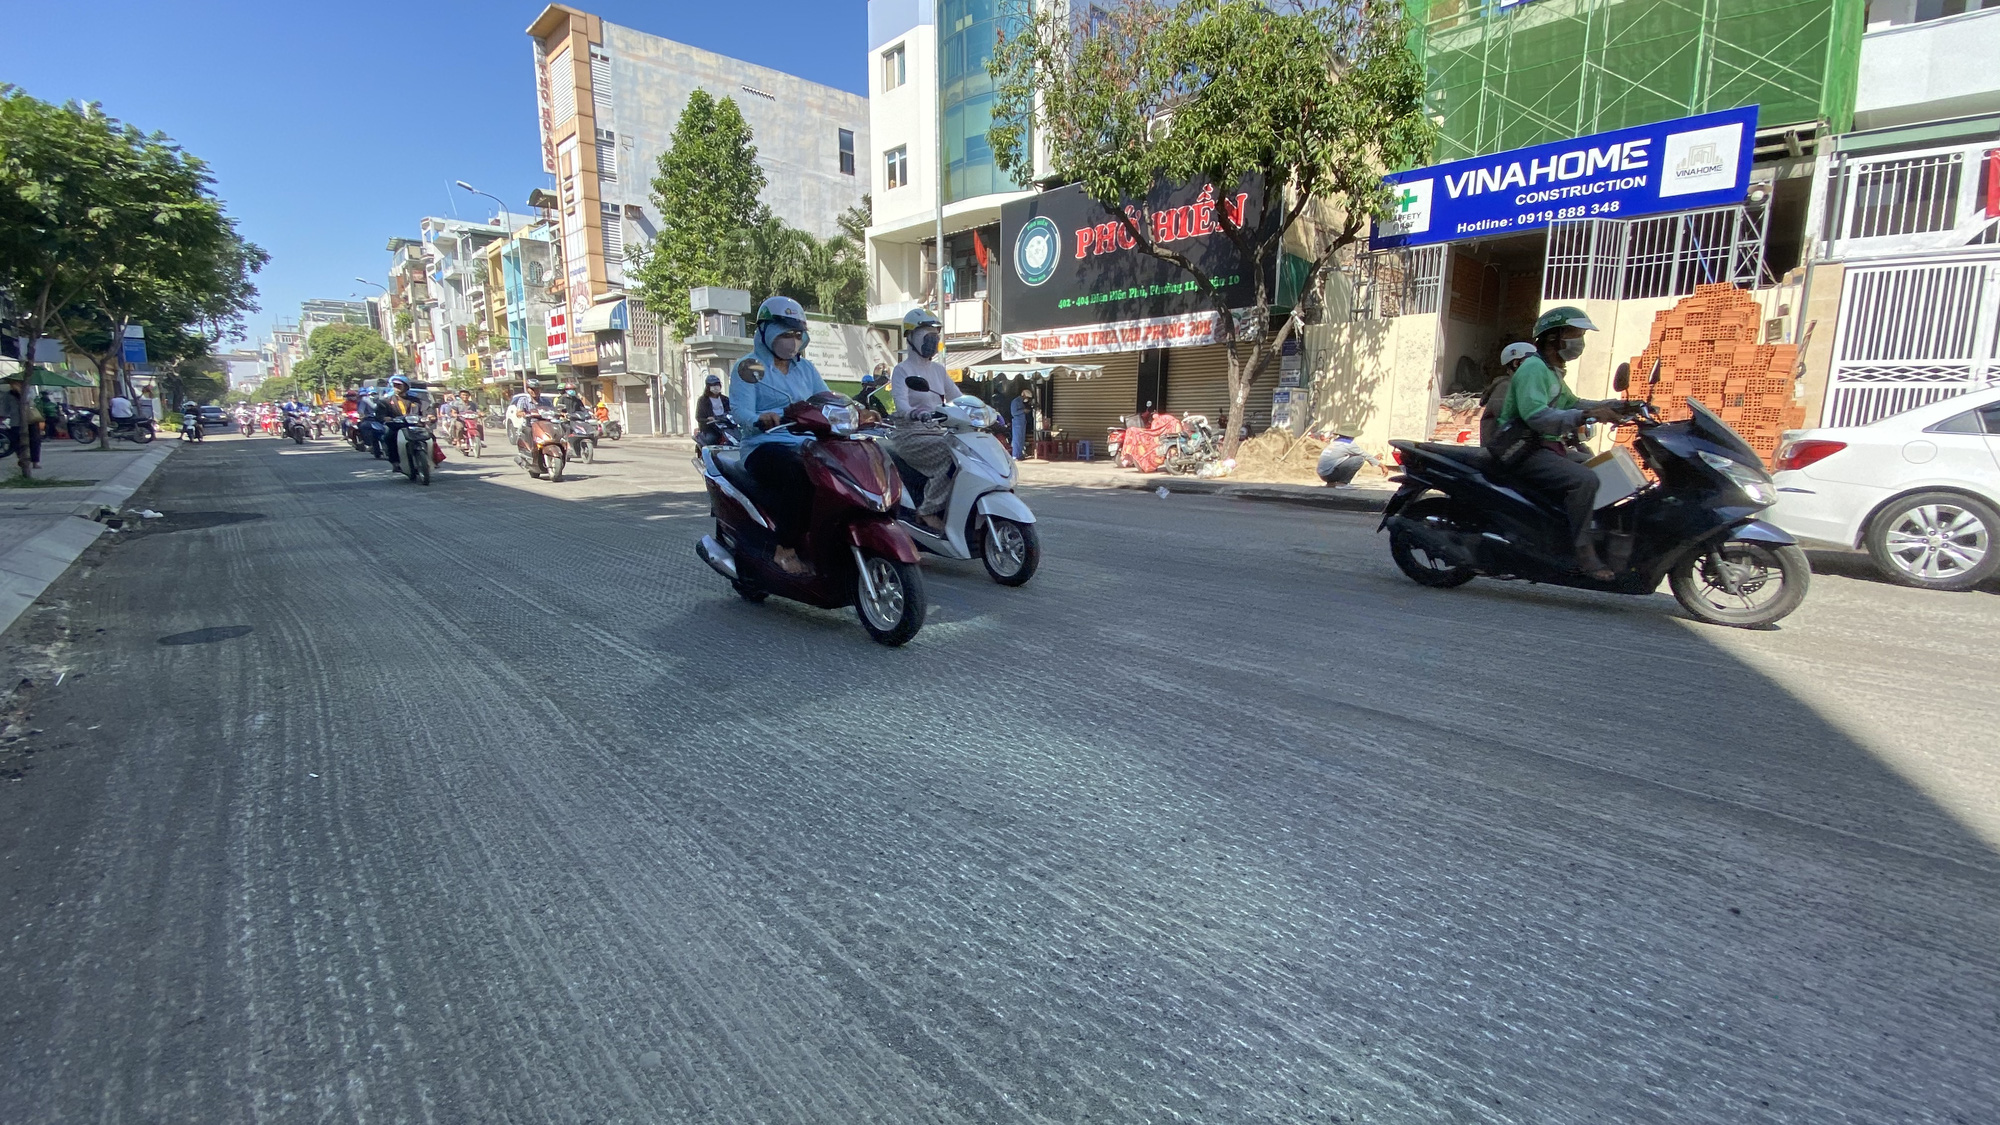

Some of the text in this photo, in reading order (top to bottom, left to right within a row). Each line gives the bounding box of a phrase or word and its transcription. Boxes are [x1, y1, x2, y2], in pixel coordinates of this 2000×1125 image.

[1445, 138, 1651, 199] VINAHOME
[1675, 164, 1723, 177] VINAHOME
[1515, 175, 1647, 206] CONSTRUCTION
[1457, 201, 1620, 233] Hotline: 0919 888 348
[1228, 275, 1240, 286] 10
